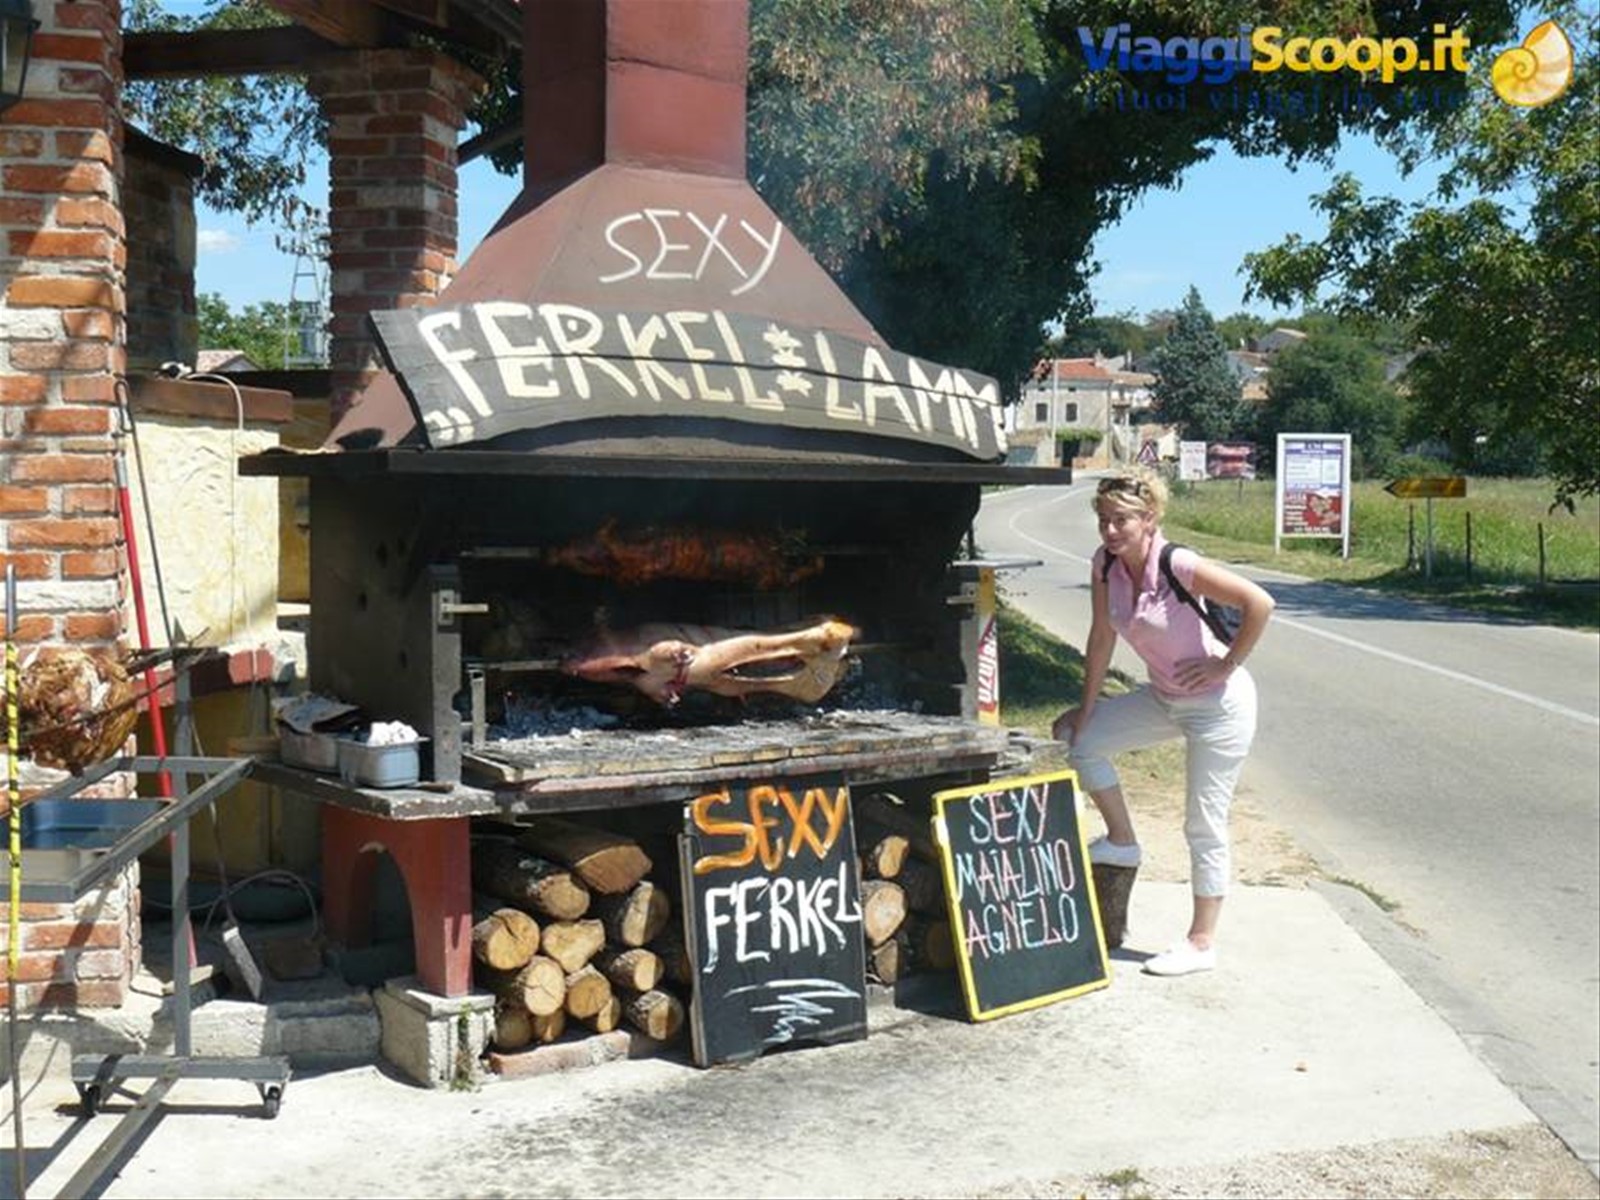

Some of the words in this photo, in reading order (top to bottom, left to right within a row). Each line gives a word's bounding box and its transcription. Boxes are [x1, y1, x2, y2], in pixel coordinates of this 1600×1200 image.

[599, 208, 783, 295] SEXY
[814, 331, 1008, 453] LAMM
[691, 784, 847, 875] SEXY
[969, 782, 1049, 844] SEXY
[955, 838, 1075, 903] MAIALINO
[701, 862, 862, 973] FERKEL
[966, 893, 1079, 959] AGNELO
